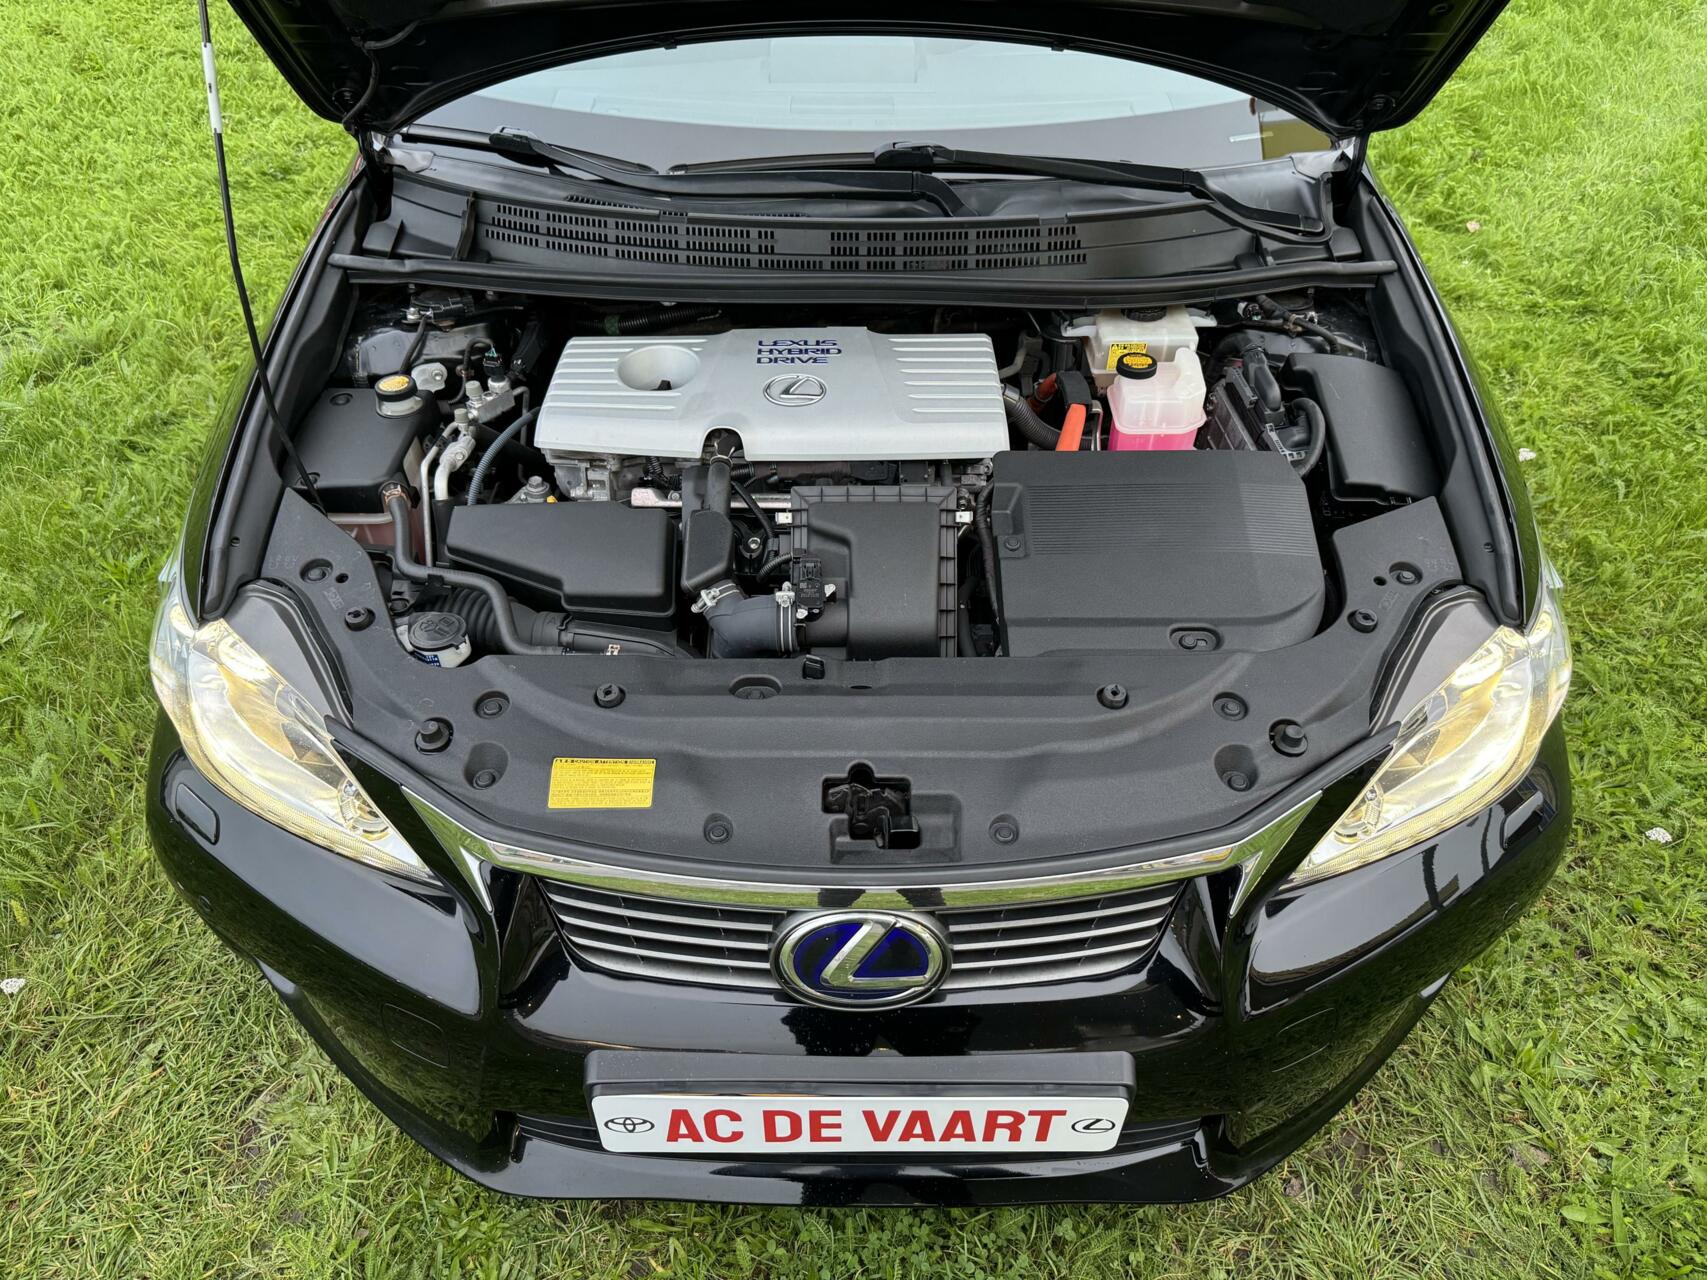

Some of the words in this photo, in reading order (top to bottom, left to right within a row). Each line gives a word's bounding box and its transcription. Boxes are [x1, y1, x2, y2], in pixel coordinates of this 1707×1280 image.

[758, 339, 837, 347] LEXUS
[756, 356, 828, 364] DRIVE
[666, 1109, 744, 1143] AC
[762, 1110, 842, 1143] DE
[862, 1110, 1067, 1142] VAART
